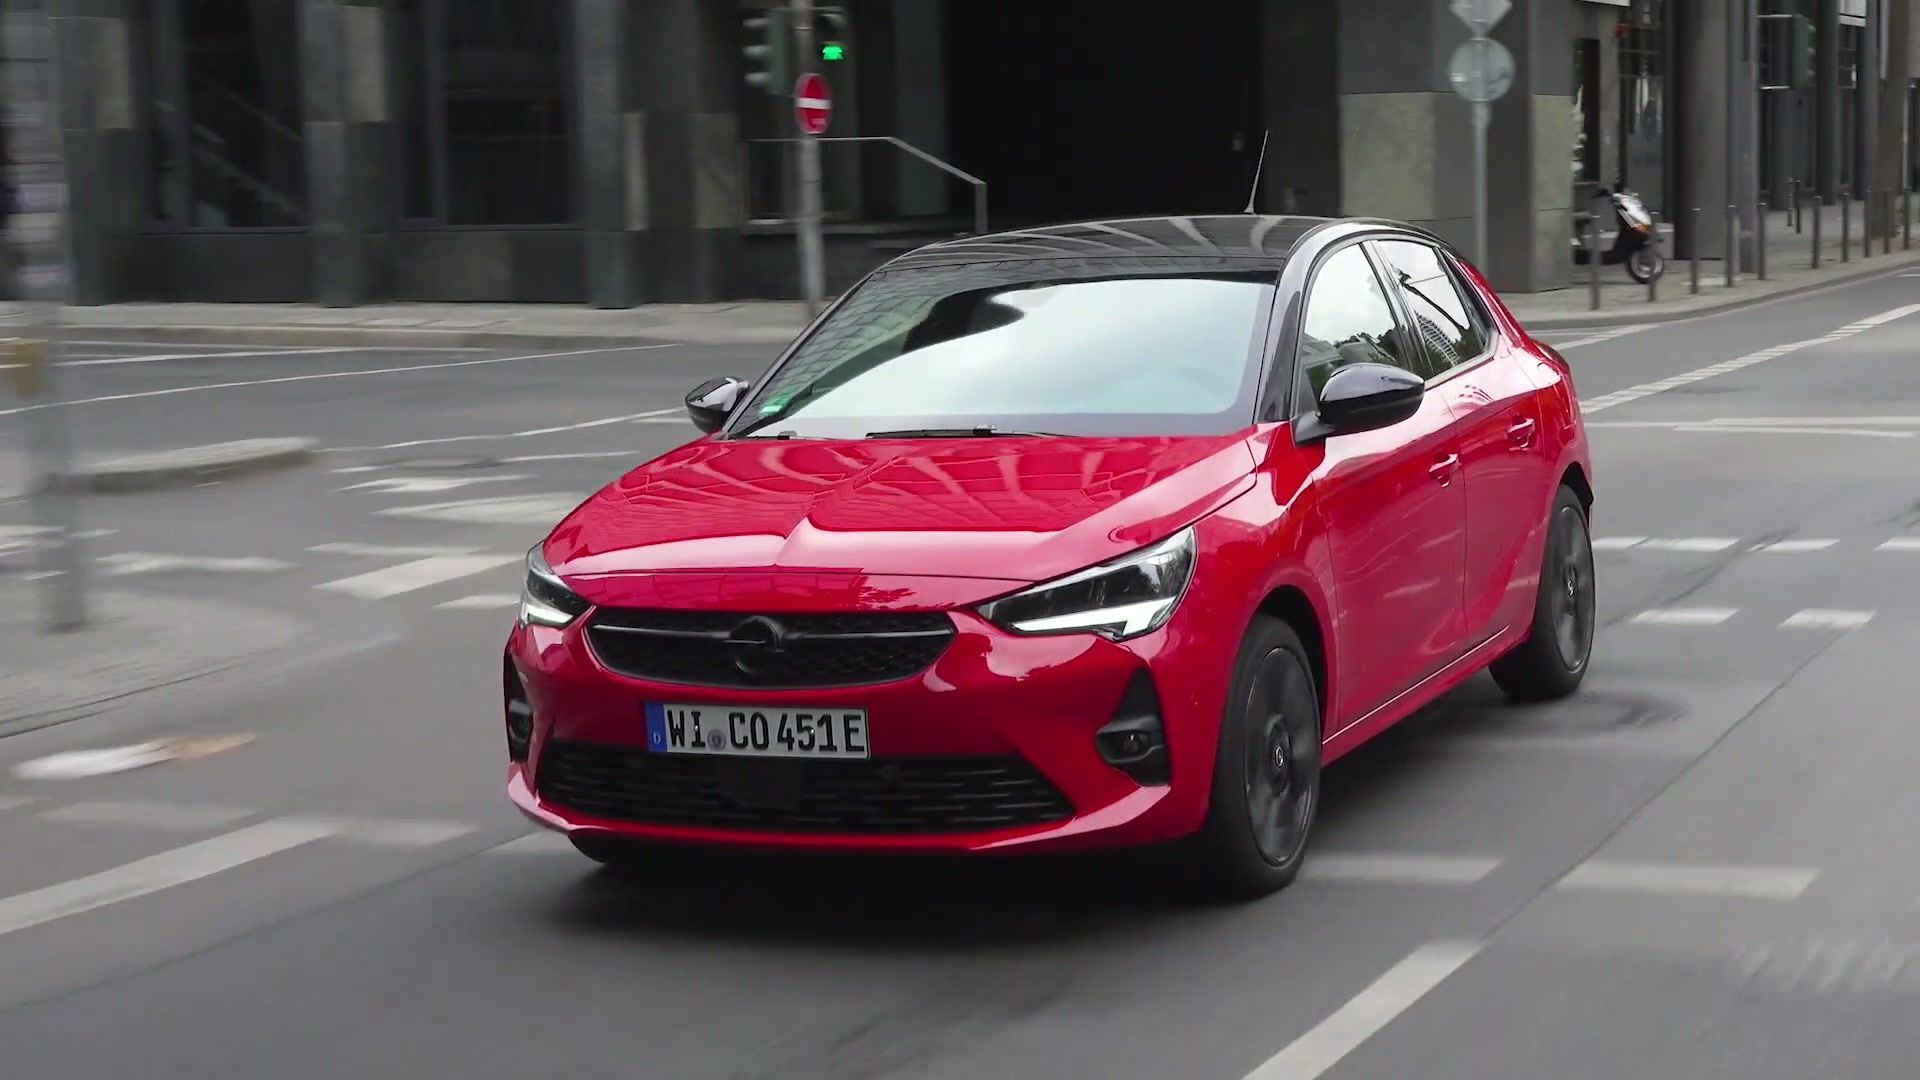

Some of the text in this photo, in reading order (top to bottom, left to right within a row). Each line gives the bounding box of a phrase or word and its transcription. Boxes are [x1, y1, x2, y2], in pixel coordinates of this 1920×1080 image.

[667, 710, 865, 752] WI CO 451E
